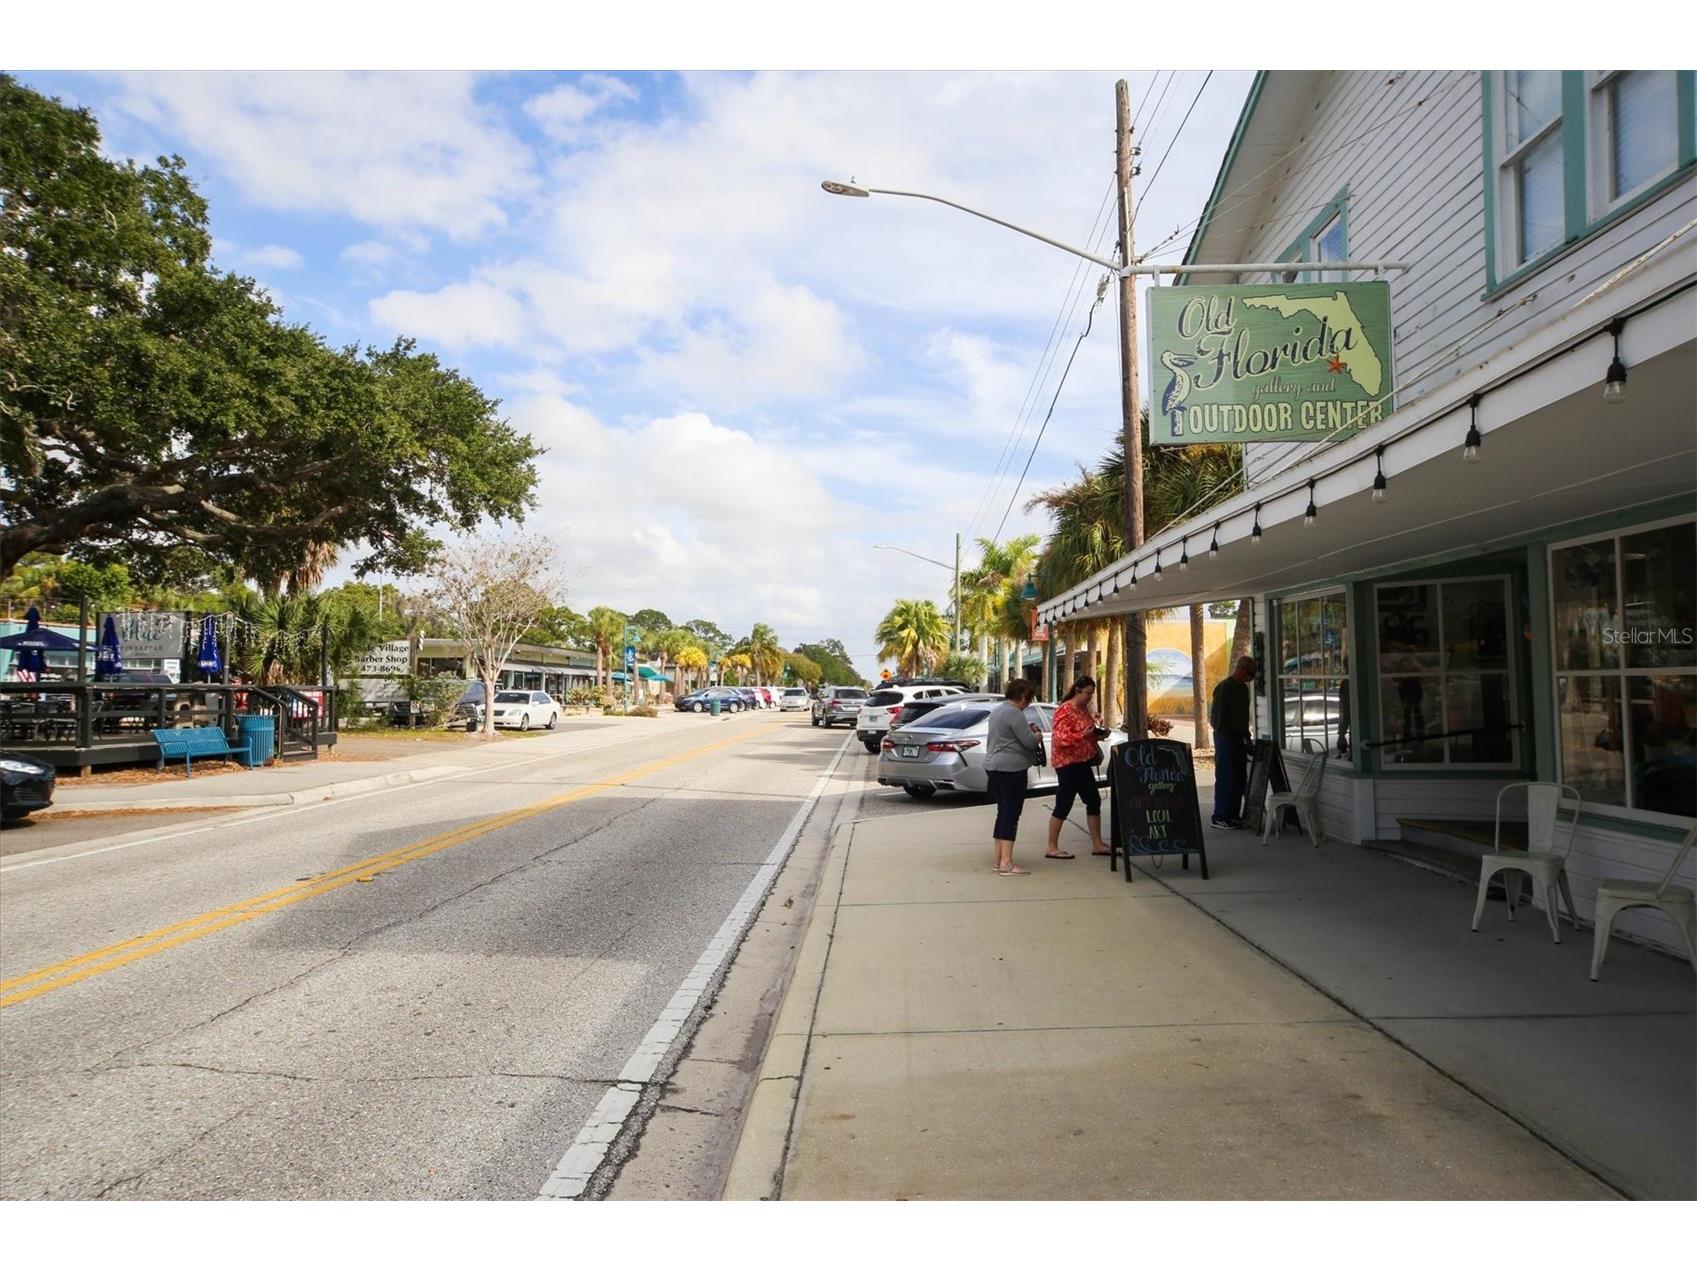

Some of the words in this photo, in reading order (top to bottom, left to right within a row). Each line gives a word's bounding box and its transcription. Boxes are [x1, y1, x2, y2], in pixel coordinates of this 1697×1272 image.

[1178, 295, 1237, 340] Old
[1192, 315, 1359, 391] Florida
[1251, 376, 1303, 400] gallery
[1307, 377, 1336, 393] and
[1188, 401, 1294, 434] OUTDOOR
[1300, 400, 1384, 432] CENTER
[378, 643, 409, 653] Village
[386, 654, 408, 664] Shop
[1124, 743, 1158, 768] Old
